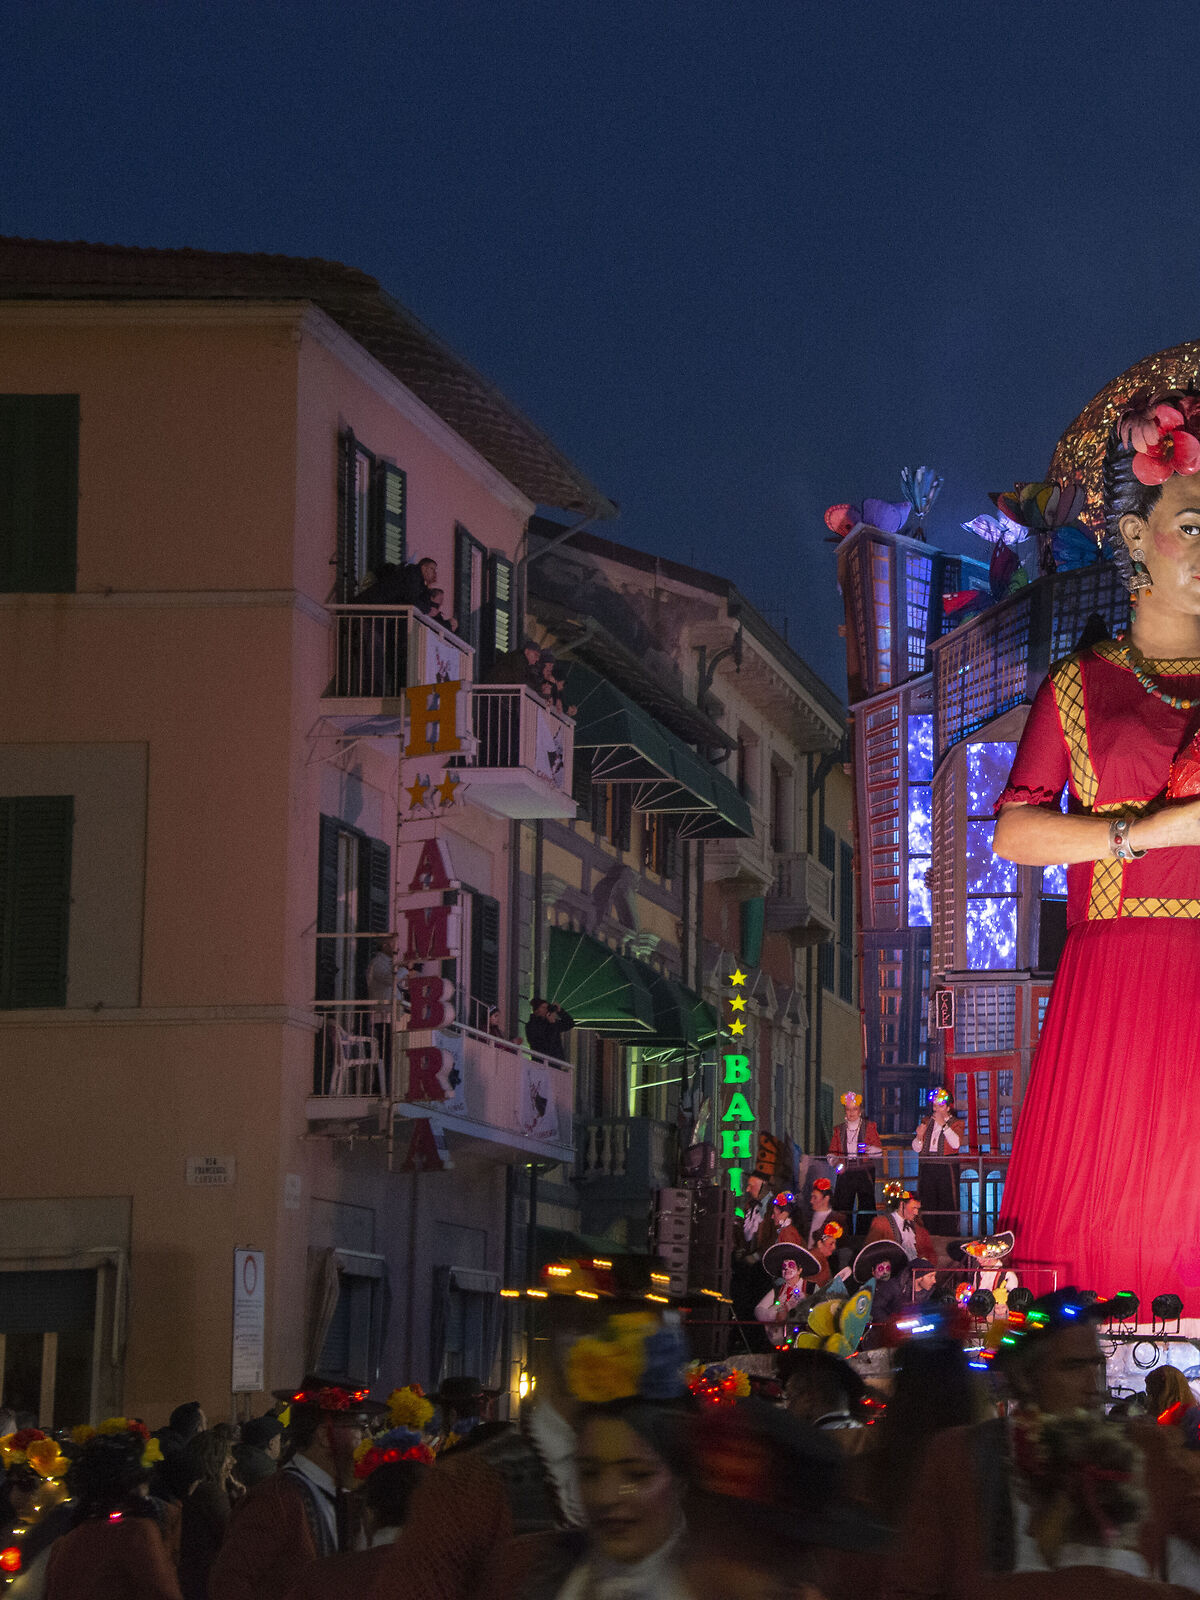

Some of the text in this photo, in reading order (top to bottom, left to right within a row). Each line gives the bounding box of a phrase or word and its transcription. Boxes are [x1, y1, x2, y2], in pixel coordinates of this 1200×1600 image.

[405, 681, 462, 756] H
[401, 838, 453, 1172] AMBRA
[721, 1055, 756, 1218] BAHI
